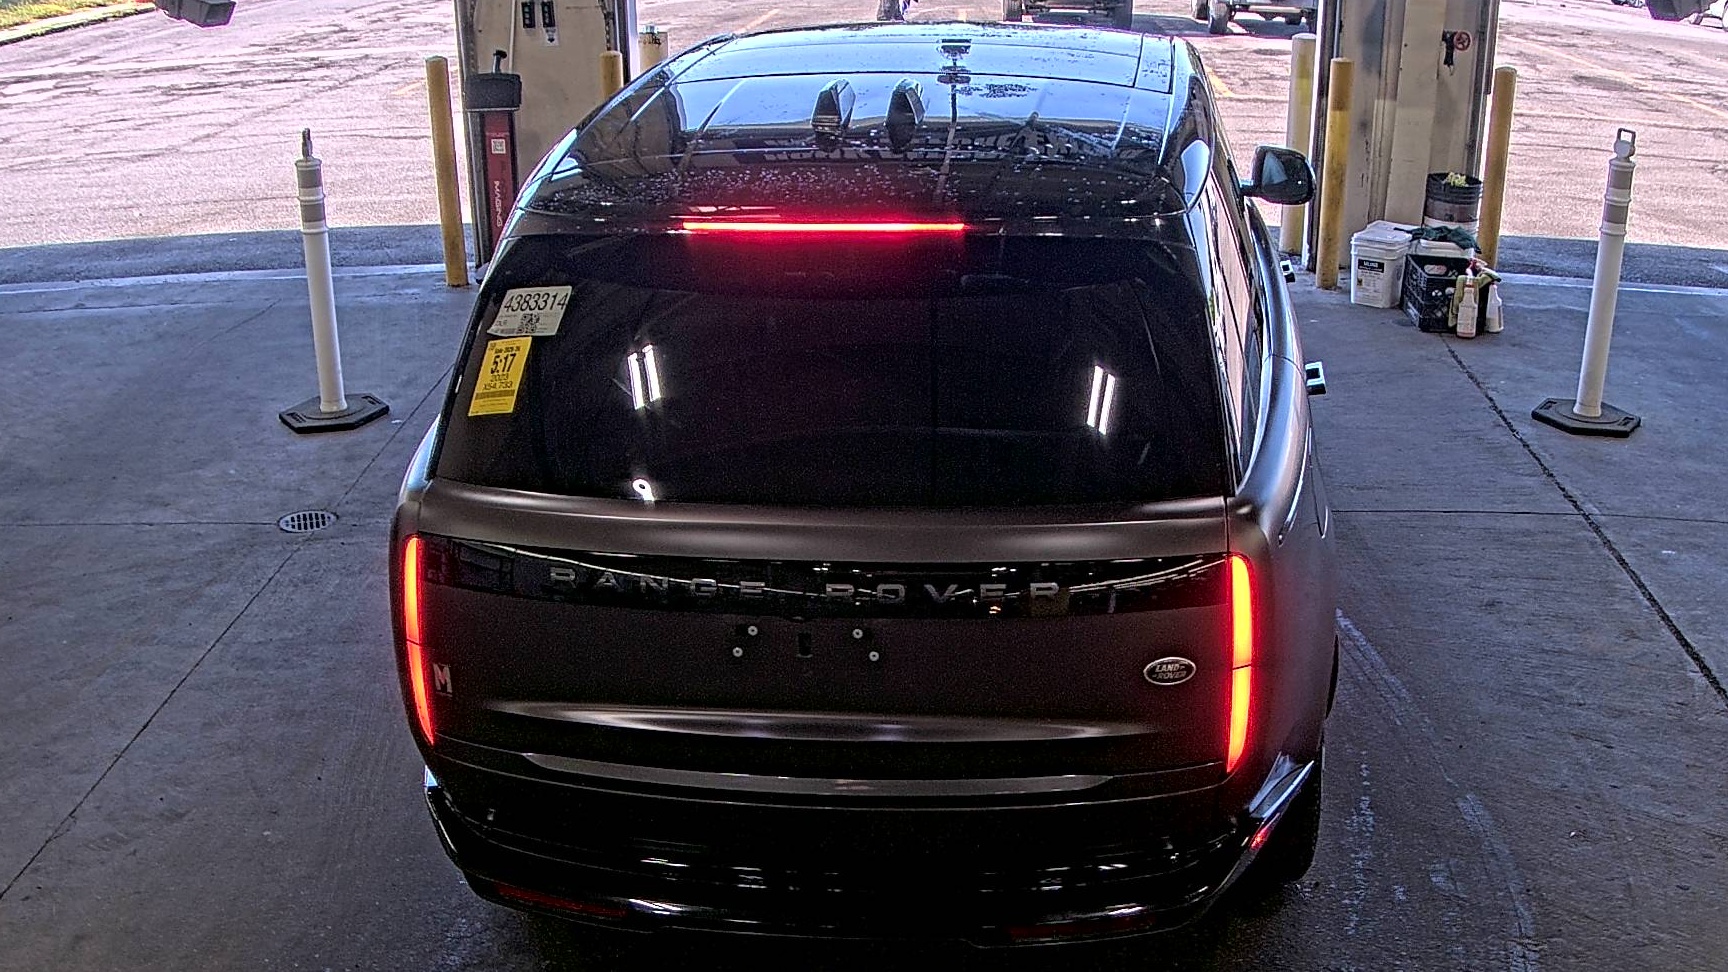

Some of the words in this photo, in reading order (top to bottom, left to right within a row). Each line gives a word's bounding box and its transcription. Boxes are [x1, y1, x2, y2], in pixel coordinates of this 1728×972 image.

[504, 292, 568, 312] 4383314
[490, 353, 517, 374] 5:17
[550, 567, 766, 598] RANGE
[826, 582, 1060, 603] ROVER
